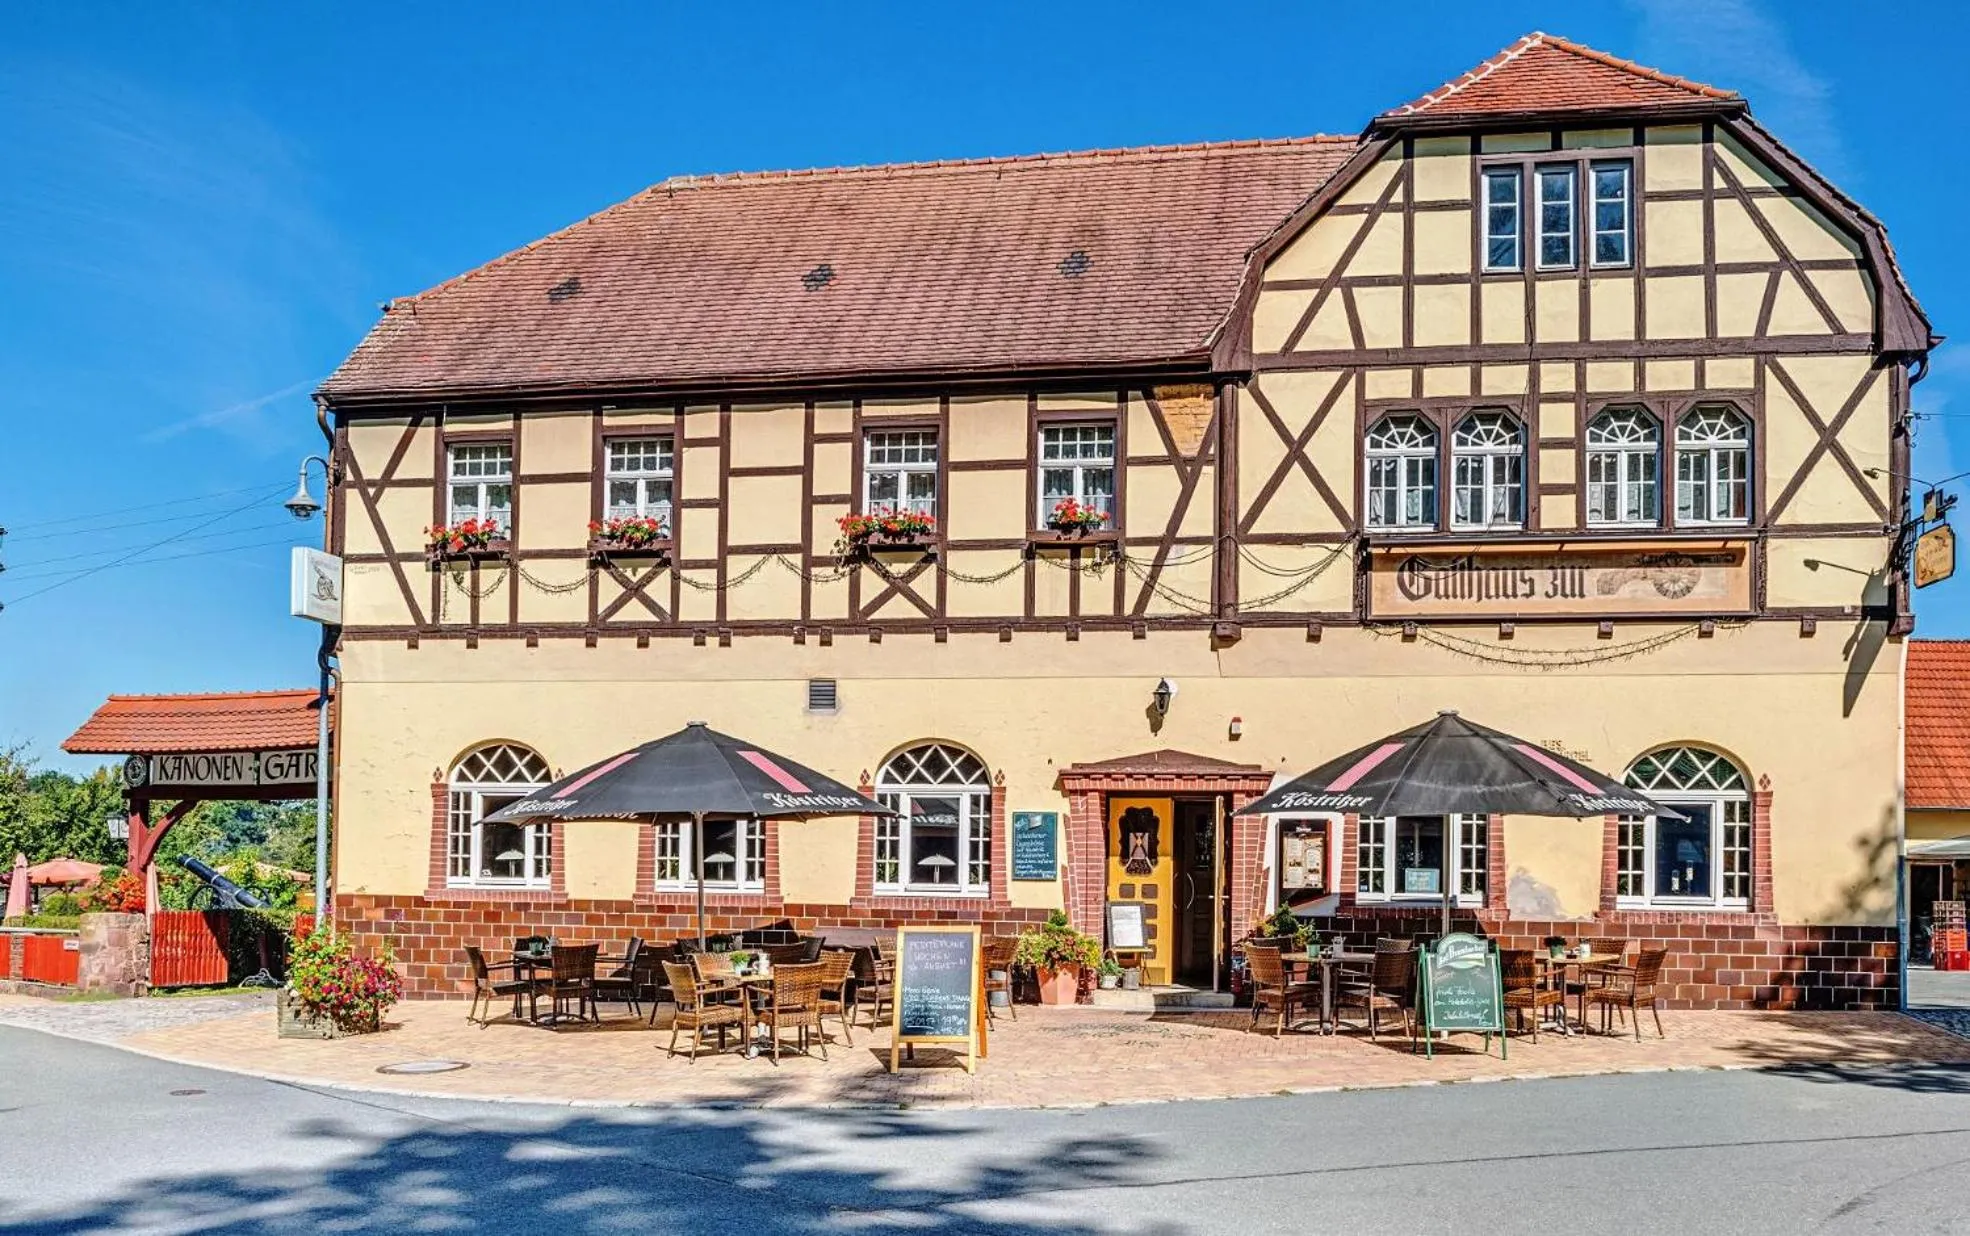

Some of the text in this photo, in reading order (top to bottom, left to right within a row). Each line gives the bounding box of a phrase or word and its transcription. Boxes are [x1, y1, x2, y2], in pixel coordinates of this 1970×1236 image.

[1544, 565, 1592, 599] zur
[158, 755, 244, 781] KANONEN
[763, 792, 864, 808] Köstritzer
[1271, 791, 1374, 809] Köstritzer
